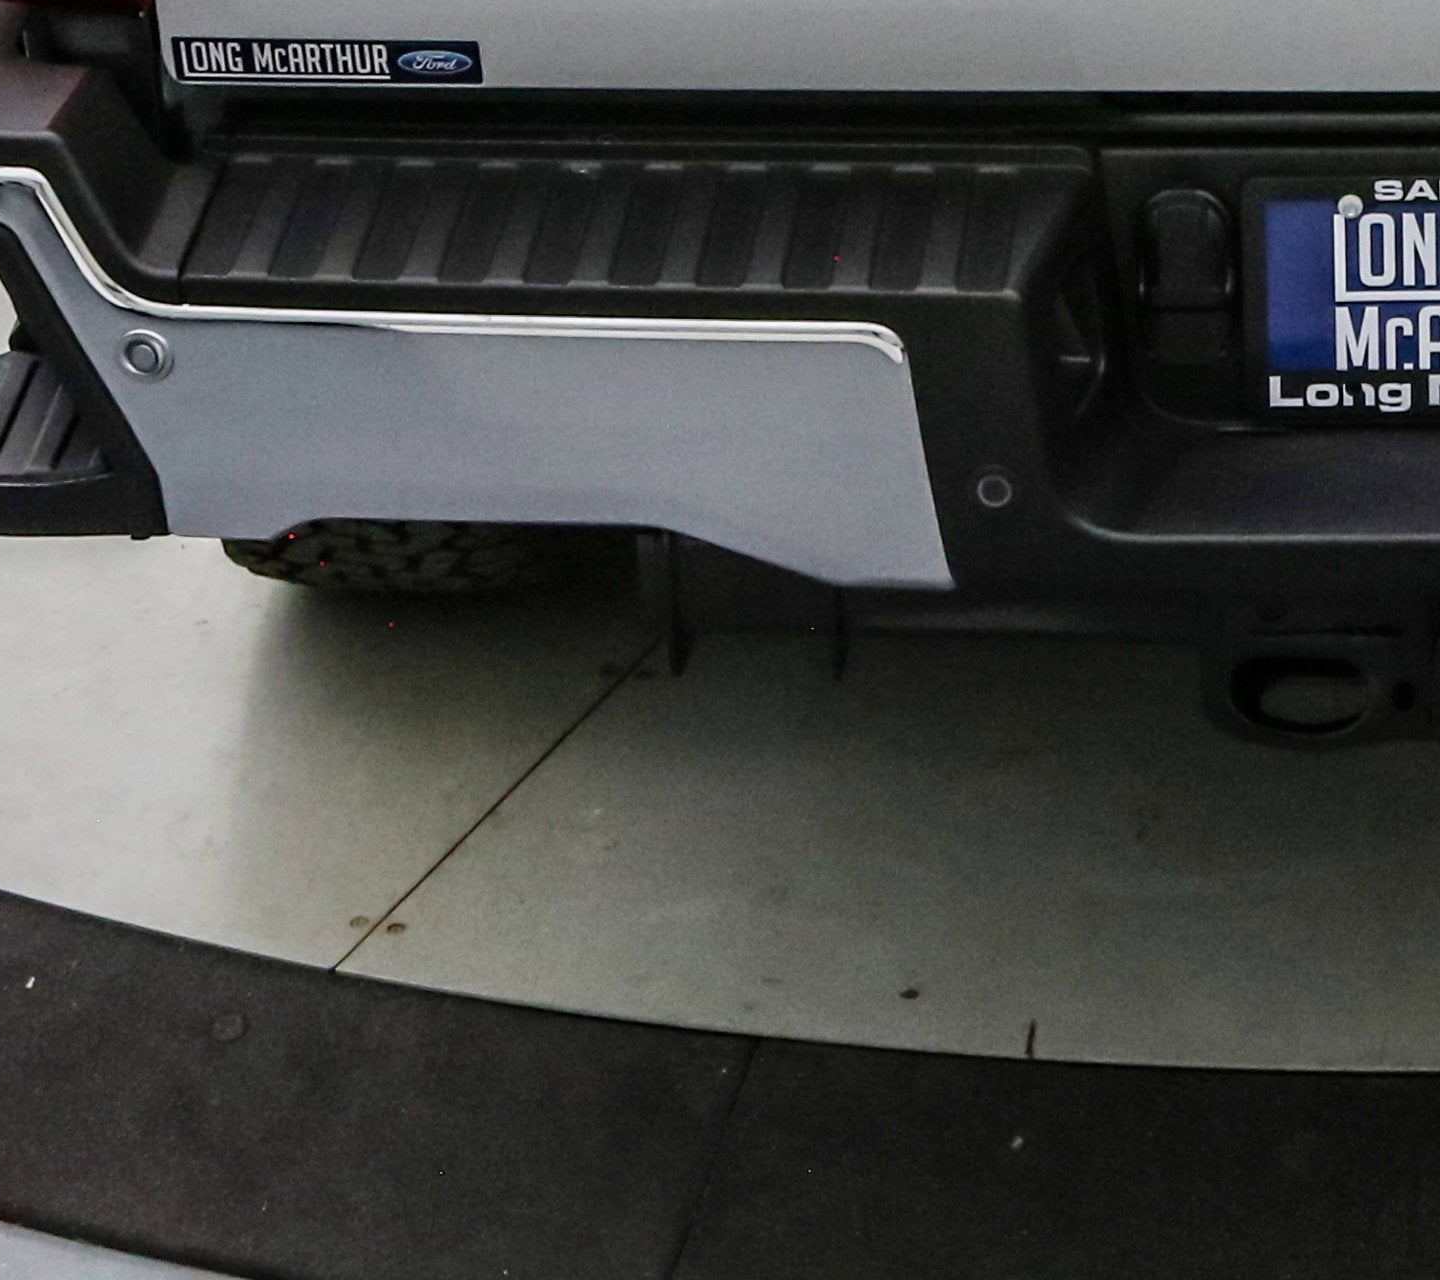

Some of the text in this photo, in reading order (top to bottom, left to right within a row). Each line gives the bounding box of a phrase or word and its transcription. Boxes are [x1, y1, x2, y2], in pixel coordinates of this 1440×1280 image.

[179, 40, 390, 77] LONG McARTHUR
[411, 53, 458, 72] Ford
[1268, 374, 1413, 413] Long
